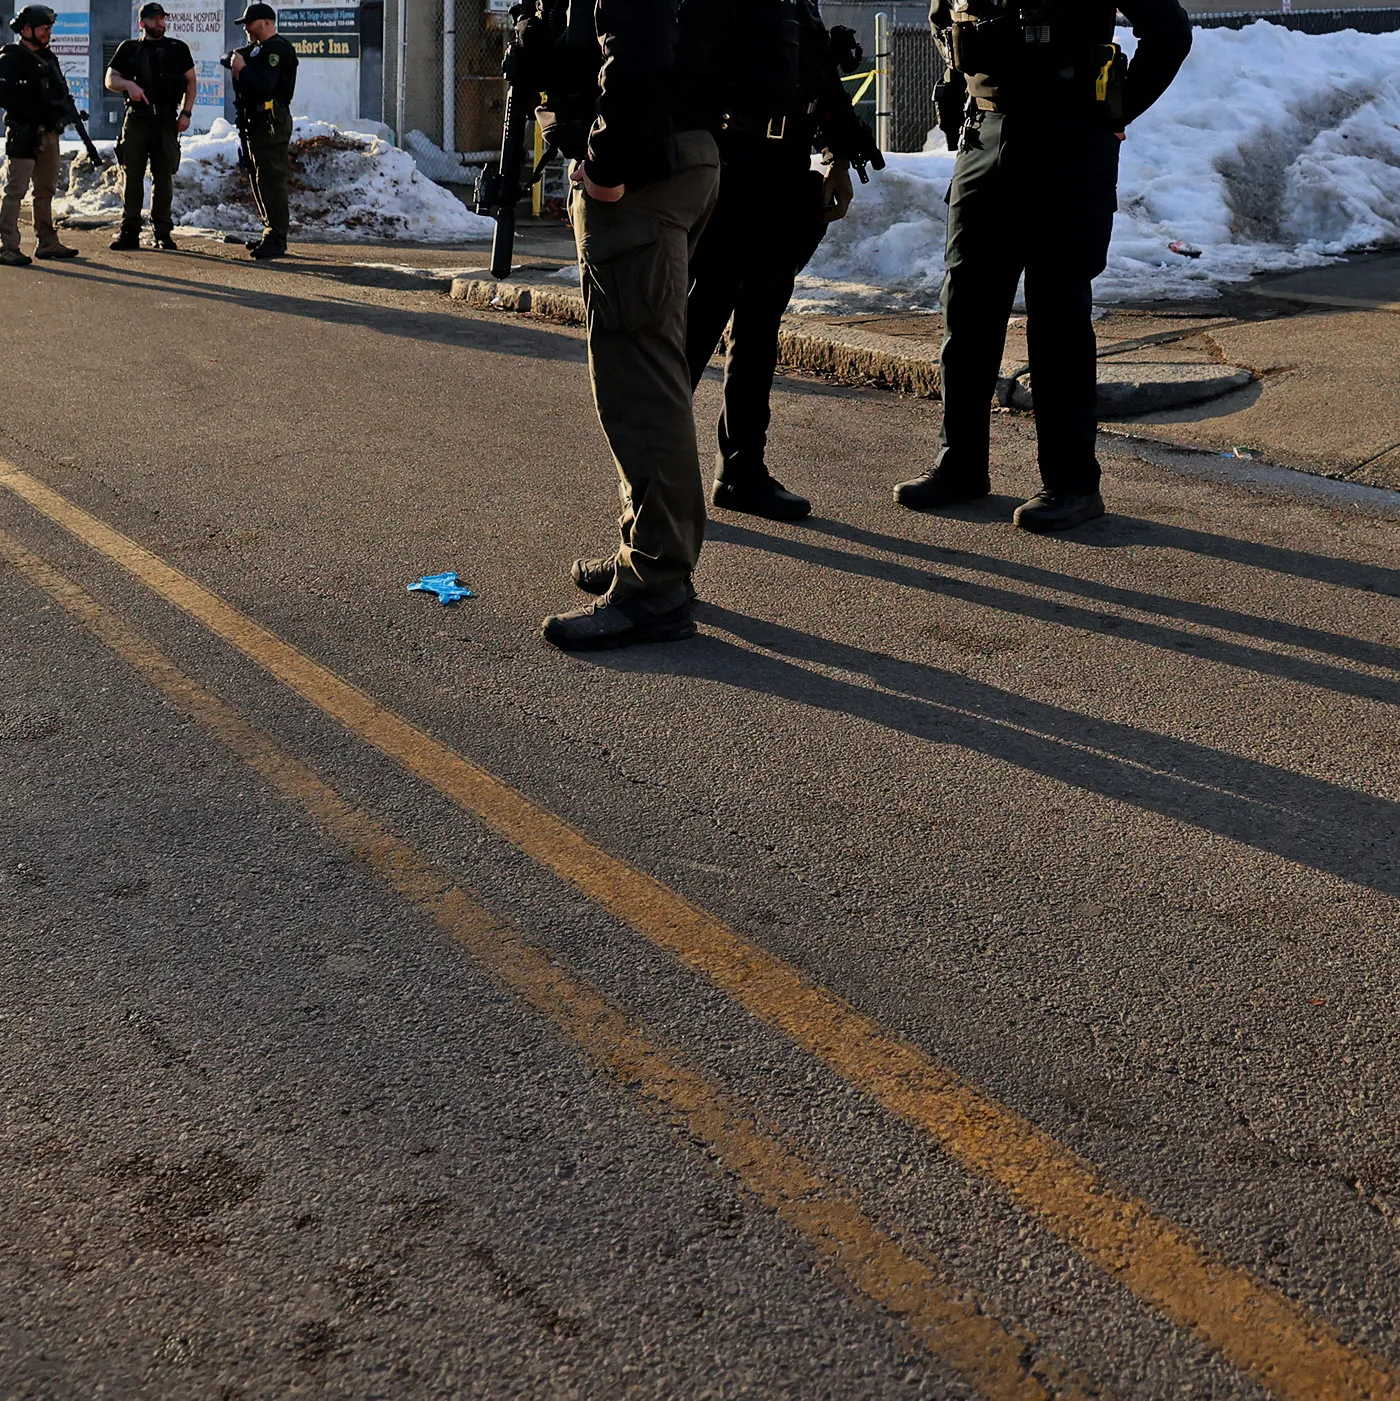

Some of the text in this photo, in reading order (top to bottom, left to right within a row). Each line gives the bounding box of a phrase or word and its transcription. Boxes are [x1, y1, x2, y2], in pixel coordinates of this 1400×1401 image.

[193, 11, 220, 22] HOSPITAL
[173, 22, 194, 32] RHODE
[195, 22, 221, 32] ISLAND
[292, 39, 349, 54] mfort Inn
